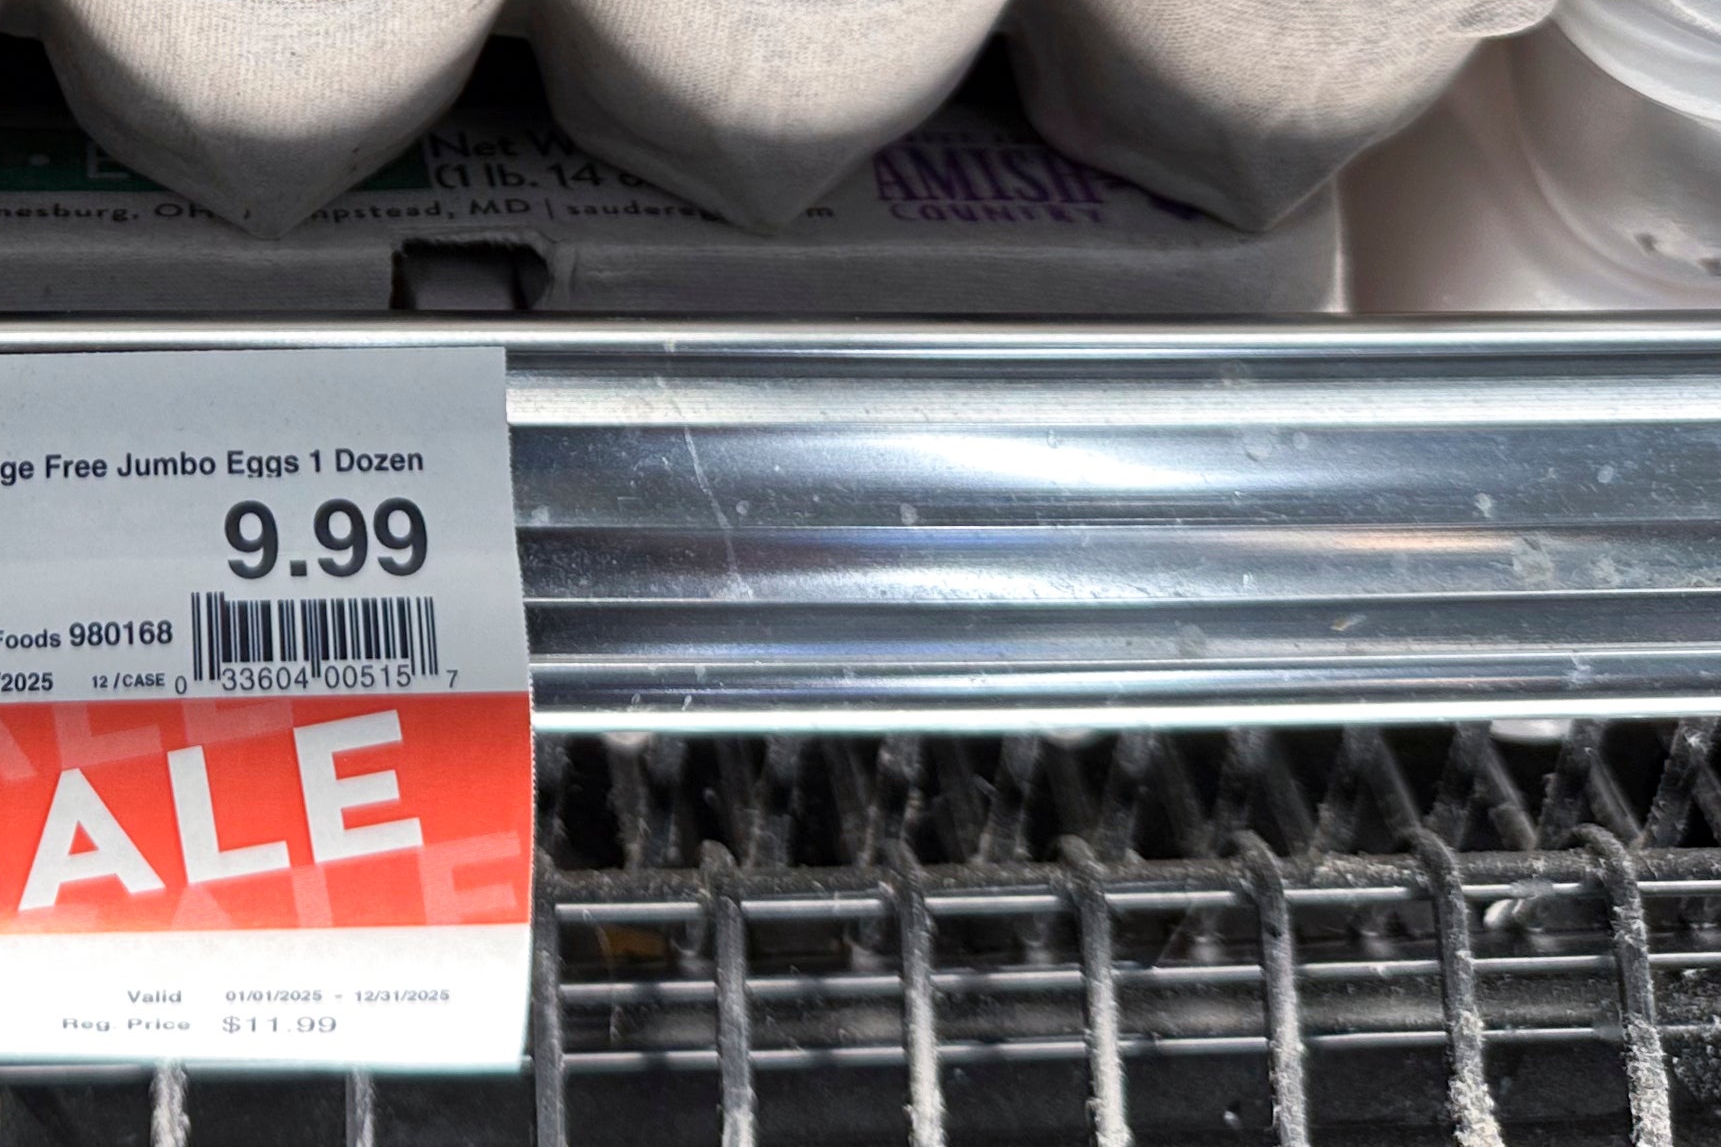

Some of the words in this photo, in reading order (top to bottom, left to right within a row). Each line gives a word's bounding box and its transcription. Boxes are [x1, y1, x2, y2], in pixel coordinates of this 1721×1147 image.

[45, 453, 108, 479] Free
[116, 451, 217, 478] Jumbo
[226, 449, 301, 479] Eggs
[308, 449, 322, 473] 1
[334, 447, 425, 473] Dozen
[223, 496, 429, 581] 9.99
[68, 618, 174, 648] 980168
[90, 675, 109, 689] 12
[174, 674, 188, 695] 0
[221, 665, 310, 692] 33604
[323, 663, 412, 690] 00515
[445, 669, 460, 689] 7
[126, 989, 182, 1004] Valid
[224, 988, 323, 1003] 01/01/2025
[353, 988, 451, 1003] 12/31/2025
[61, 1017, 118, 1034] Reg.
[126, 1017, 192, 1032] Price
[221, 1014, 338, 1035] $11.99
